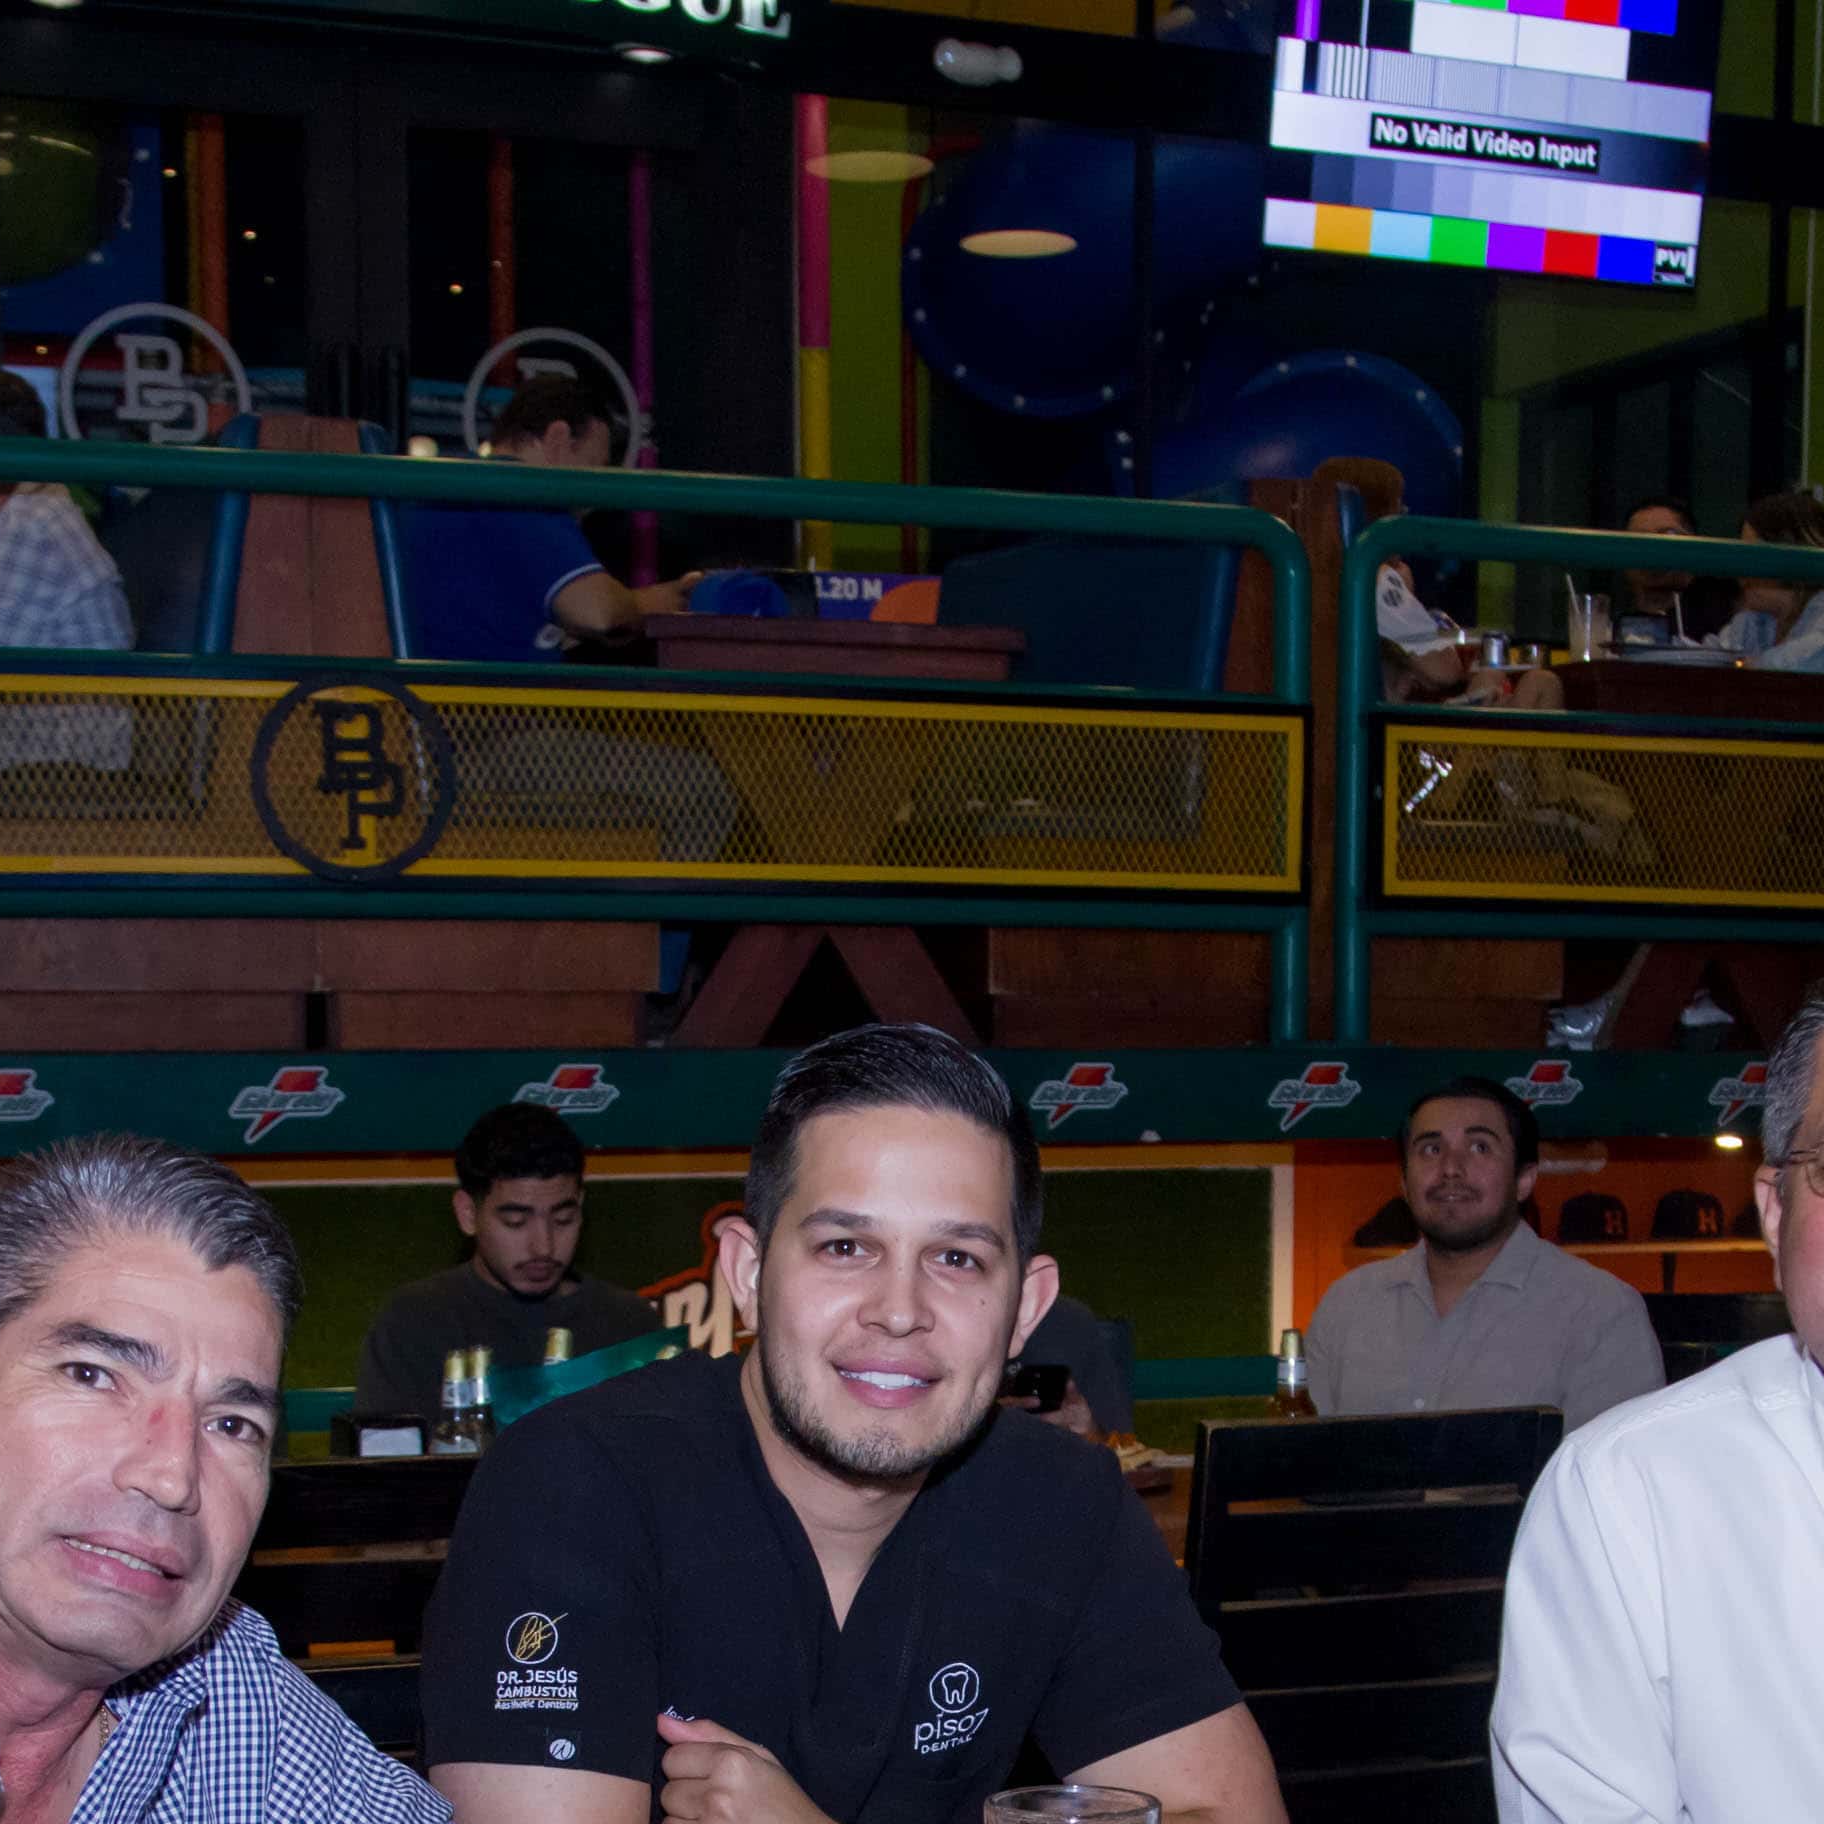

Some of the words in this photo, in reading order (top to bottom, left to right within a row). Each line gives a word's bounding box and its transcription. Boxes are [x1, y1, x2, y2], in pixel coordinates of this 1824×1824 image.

[1375, 118, 1408, 144] No
[1412, 121, 1467, 151] Valid
[1472, 129, 1535, 159] Video
[1538, 137, 1597, 168] Input
[526, 1667, 578, 1684] JESÚS
[920, 1732, 975, 1754] DENTAL
